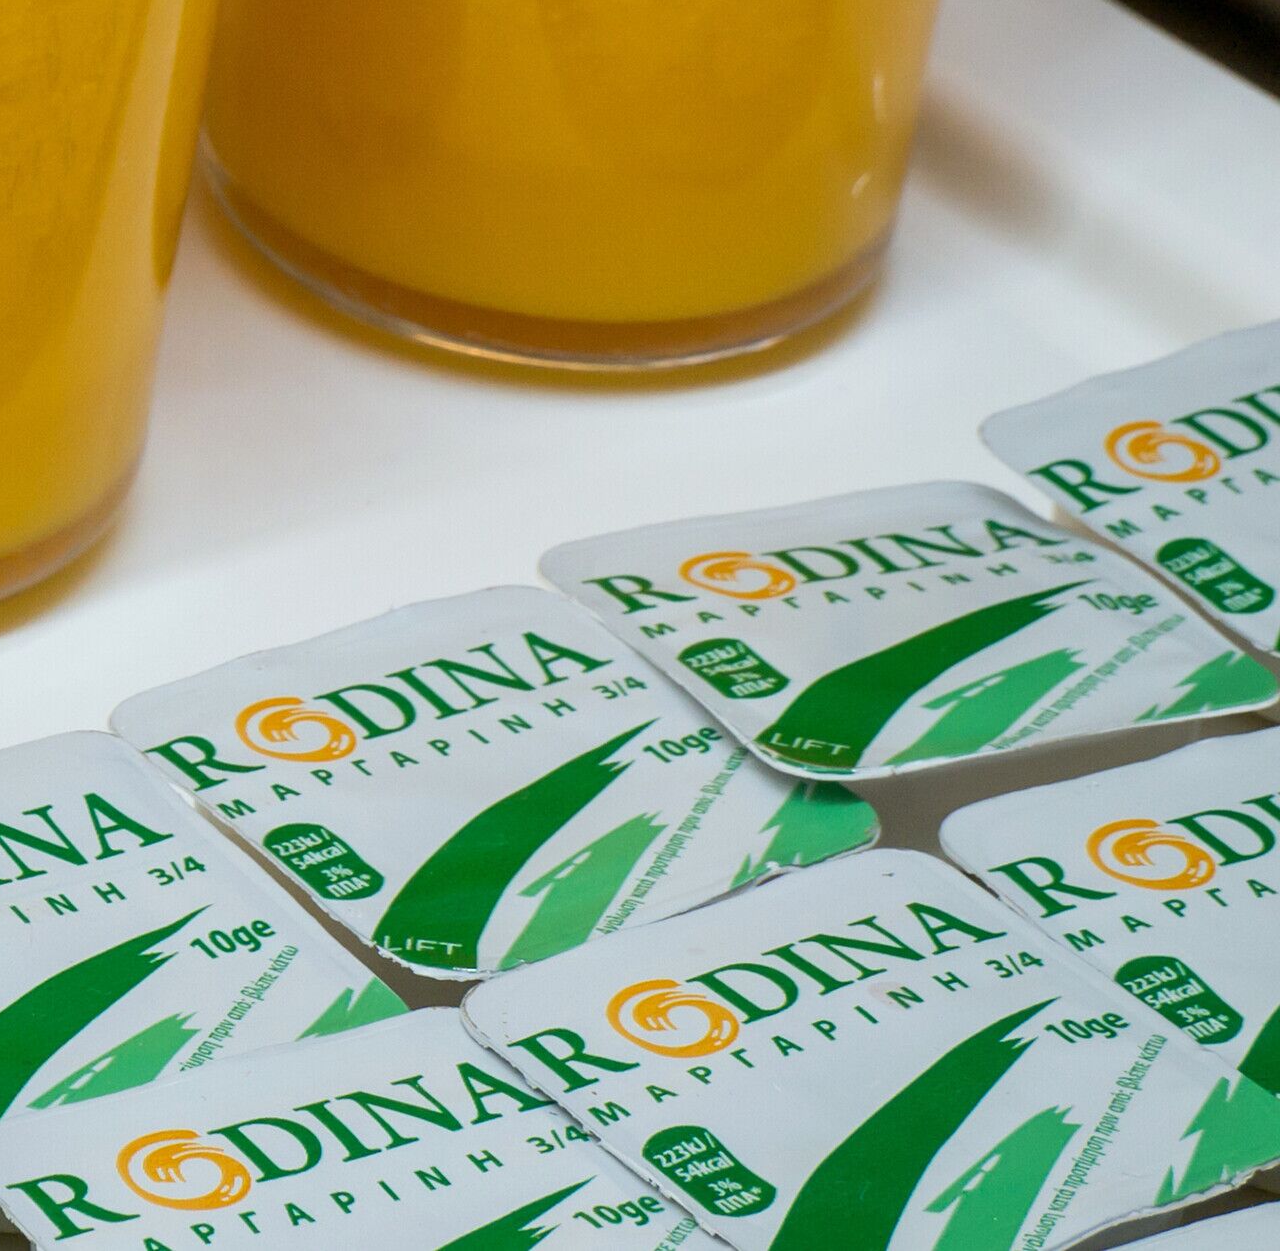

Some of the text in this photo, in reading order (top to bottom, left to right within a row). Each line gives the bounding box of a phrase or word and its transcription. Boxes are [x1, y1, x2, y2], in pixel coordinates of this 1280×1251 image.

[583, 519, 1065, 615] RODINA
[144, 630, 613, 792] RODINA
[216, 675, 647, 820] ΜΑΡΓΑΡΙΝΗ 3/4
[771, 732, 851, 757] LIFT
[149, 856, 207, 888] 3/4
[383, 935, 462, 957] LIFT
[507, 901, 1008, 1095] RODINA
[586, 950, 1045, 1127] ΜΑΡΓΑΡΙΝΗ 3/4
[6, 1063, 560, 1242] RODINA
[526, 1124, 591, 1155] 3/4
[674, 1150, 735, 1183] 54kcal
